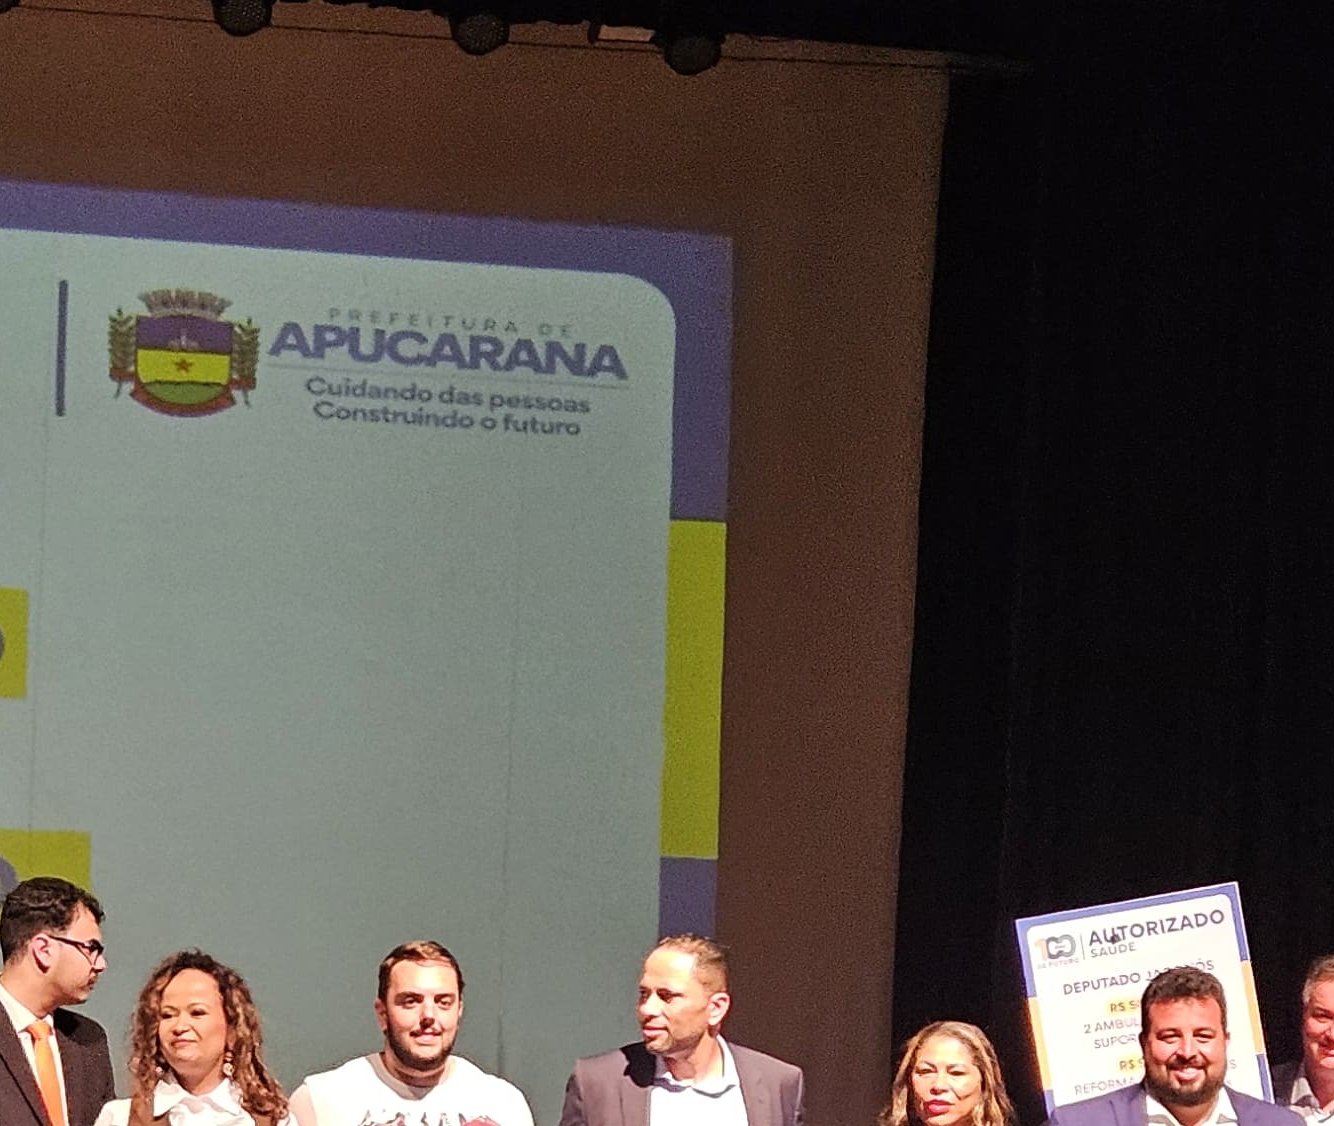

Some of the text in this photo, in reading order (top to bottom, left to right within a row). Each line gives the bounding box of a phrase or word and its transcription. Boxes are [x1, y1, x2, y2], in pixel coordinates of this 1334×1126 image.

[328, 306, 573, 338] PREFEITURA DE
[267, 321, 629, 381] APUCARANA
[305, 375, 591, 415] Cuidando das pessoas
[313, 401, 582, 437] Construindo o futuro
[1088, 909, 1225, 947] AUTORIZADO
[1062, 972, 1141, 996] DEPUTADO
